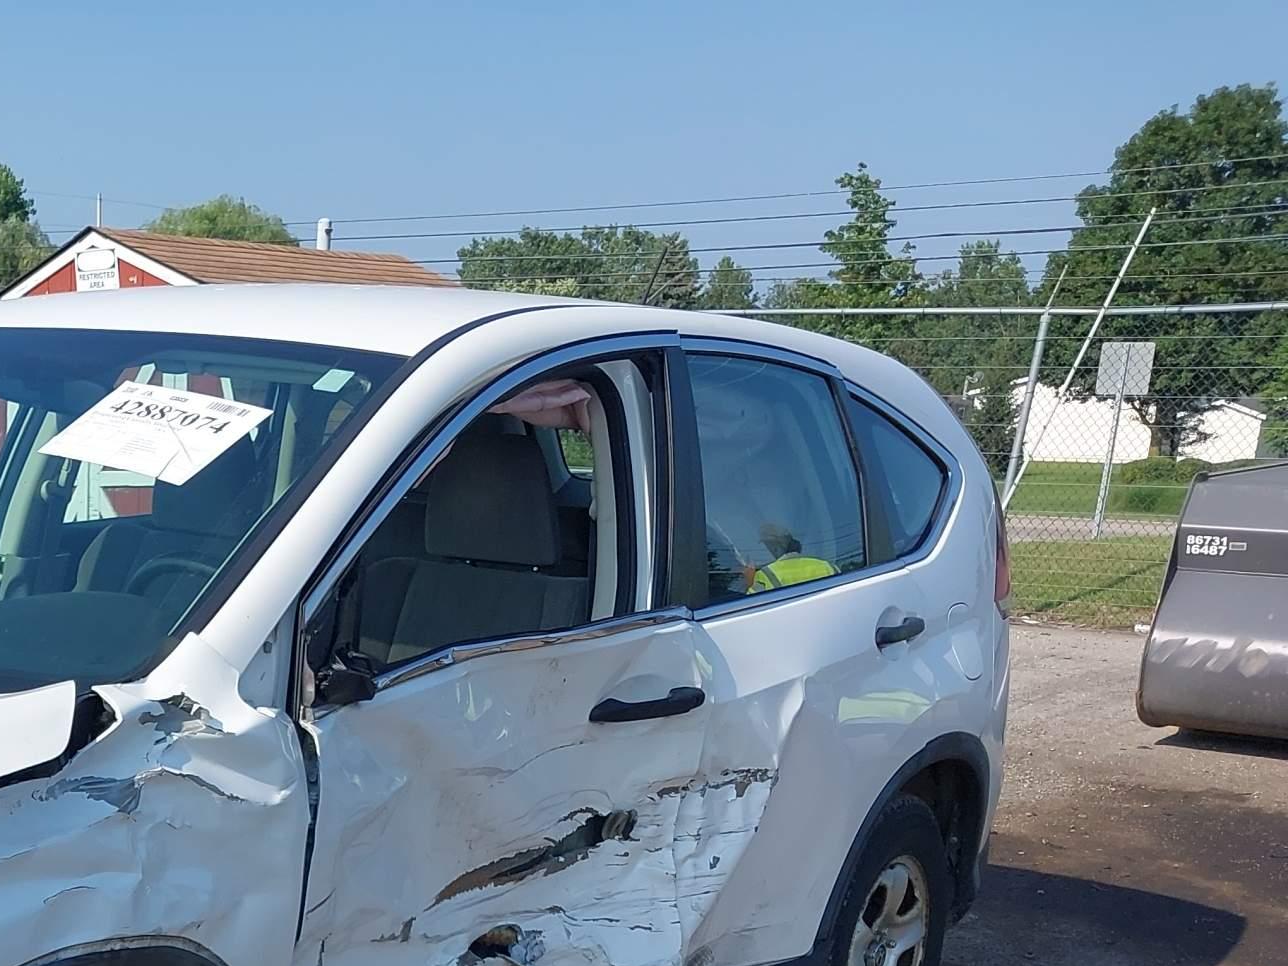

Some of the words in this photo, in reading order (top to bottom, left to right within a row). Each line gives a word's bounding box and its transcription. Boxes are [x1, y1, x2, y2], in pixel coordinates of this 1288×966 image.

[79, 271, 115, 281] RESTRICTED
[89, 281, 105, 289] AREA
[109, 398, 232, 435] 42887074
[1186, 534, 1228, 546] 86731
